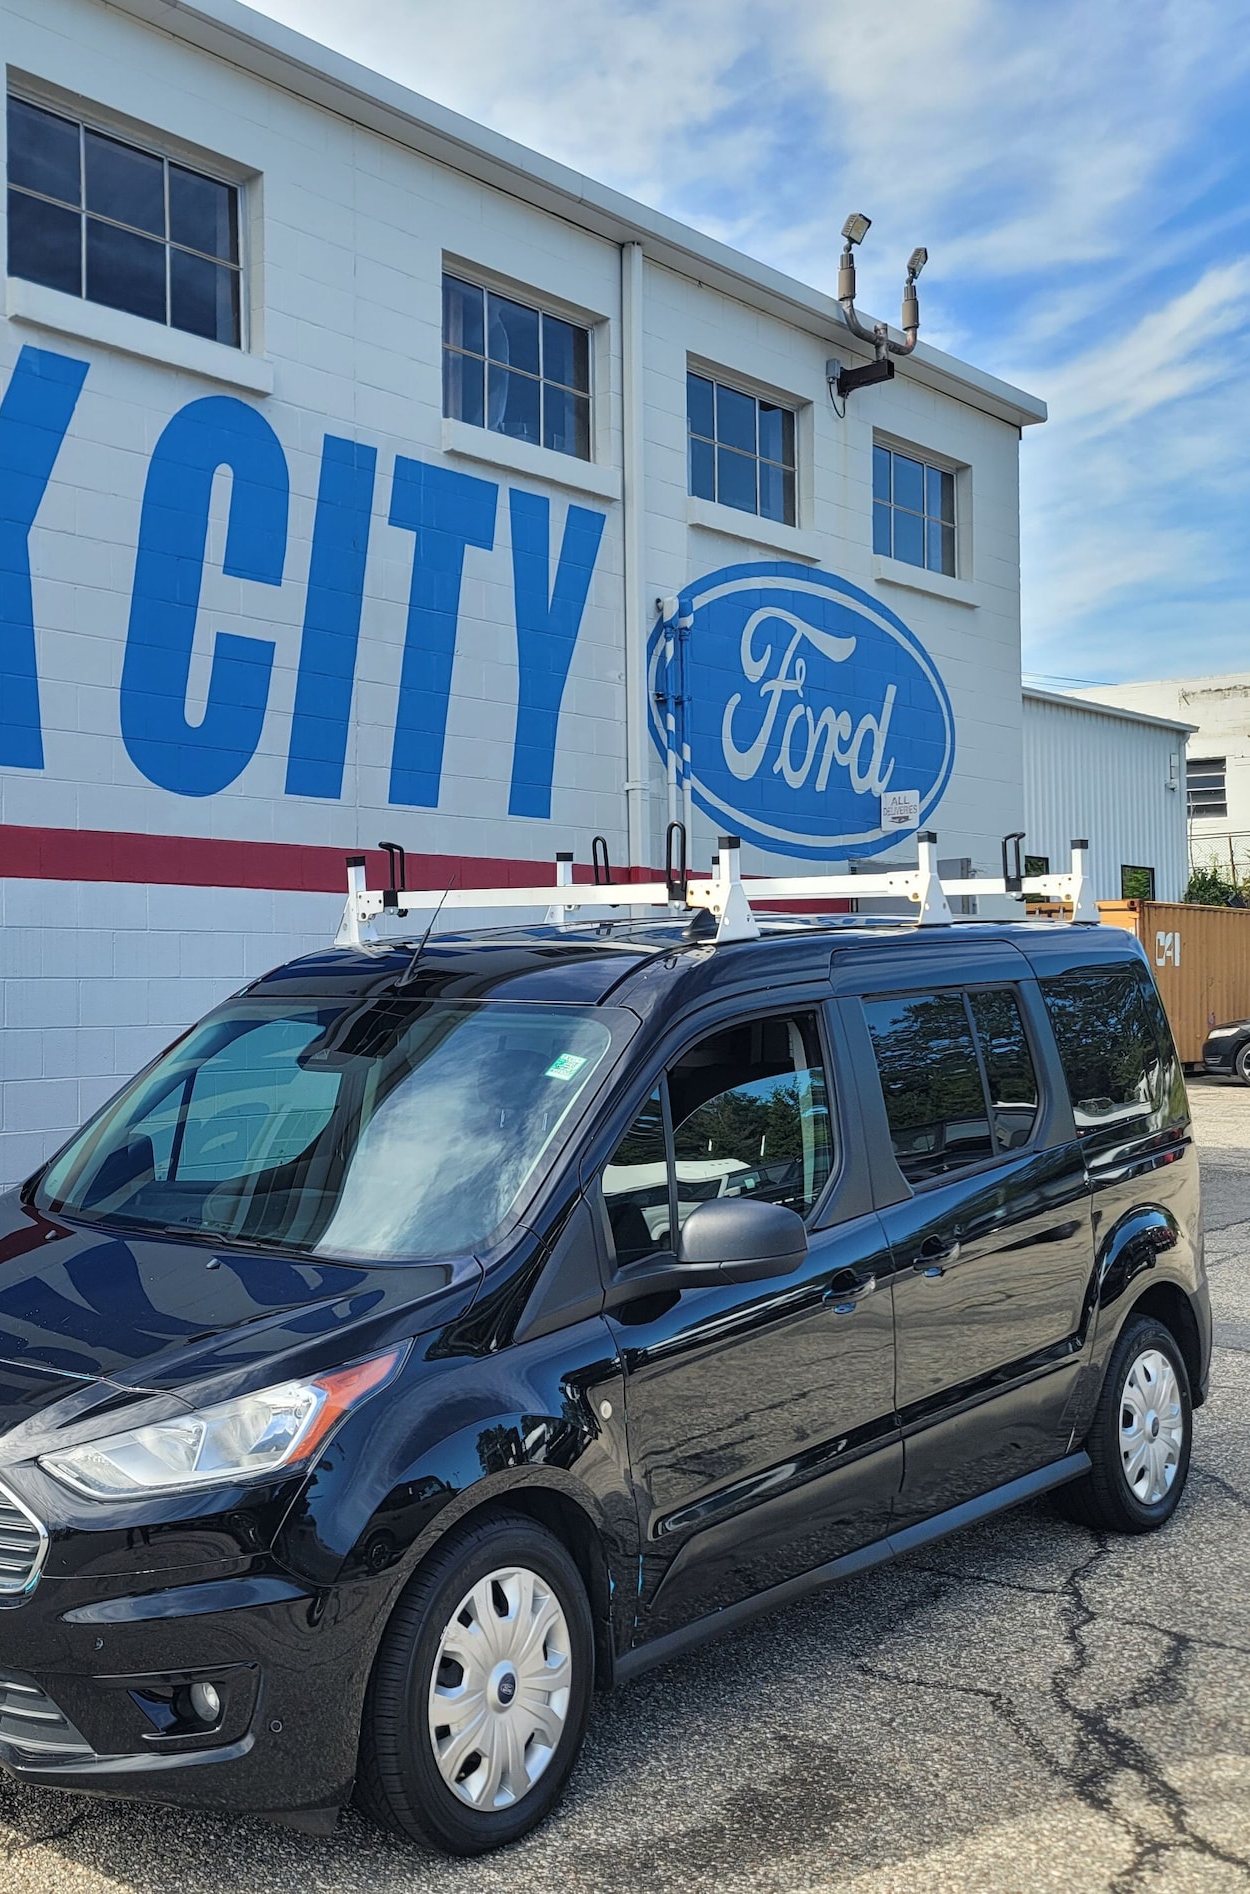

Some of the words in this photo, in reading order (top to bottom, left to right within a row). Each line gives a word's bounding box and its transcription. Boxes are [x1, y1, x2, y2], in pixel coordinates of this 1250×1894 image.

[119, 394, 607, 820] CITY
[721, 606, 898, 797] Ford
[883, 804, 917, 816] DELIVERIES
[891, 796, 910, 805] ALL
[1155, 930, 1181, 967] CAI
